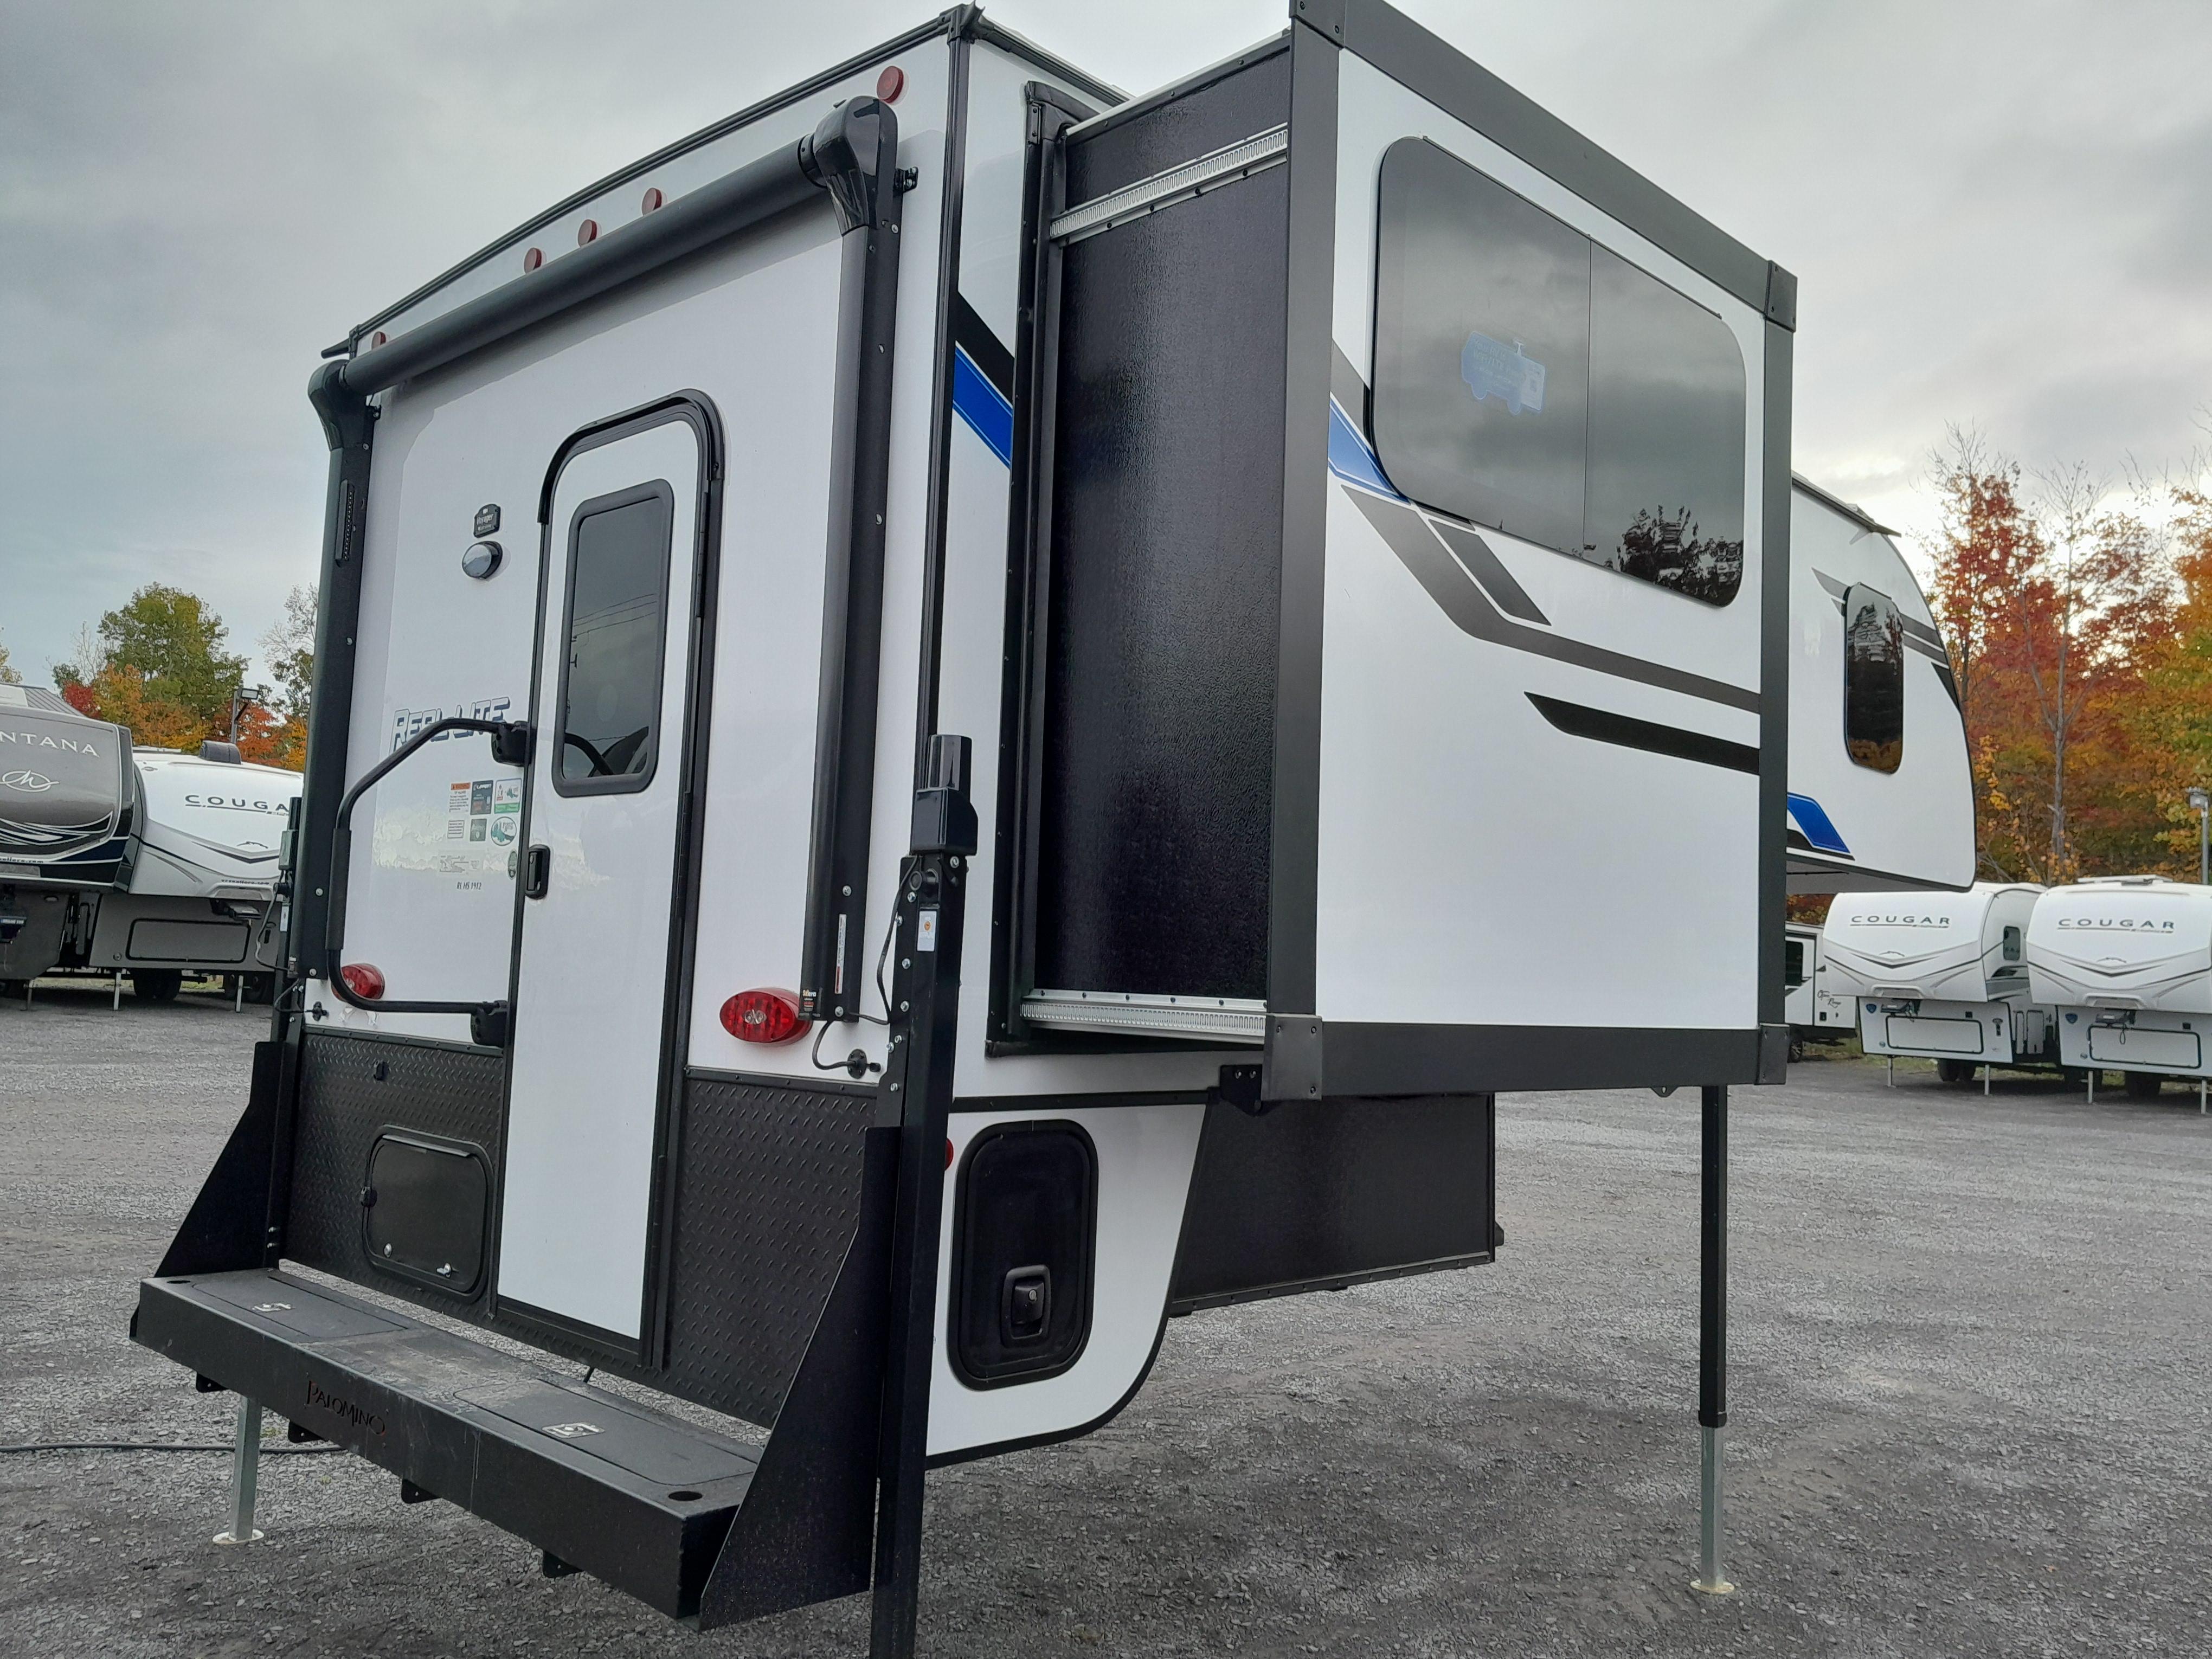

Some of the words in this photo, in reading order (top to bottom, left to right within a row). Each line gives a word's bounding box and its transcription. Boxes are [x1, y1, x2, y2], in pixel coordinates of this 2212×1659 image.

[185, 794, 290, 813] COUGA
[1851, 915, 1950, 924] COUGAR
[2058, 918, 2174, 929] COUGAR
